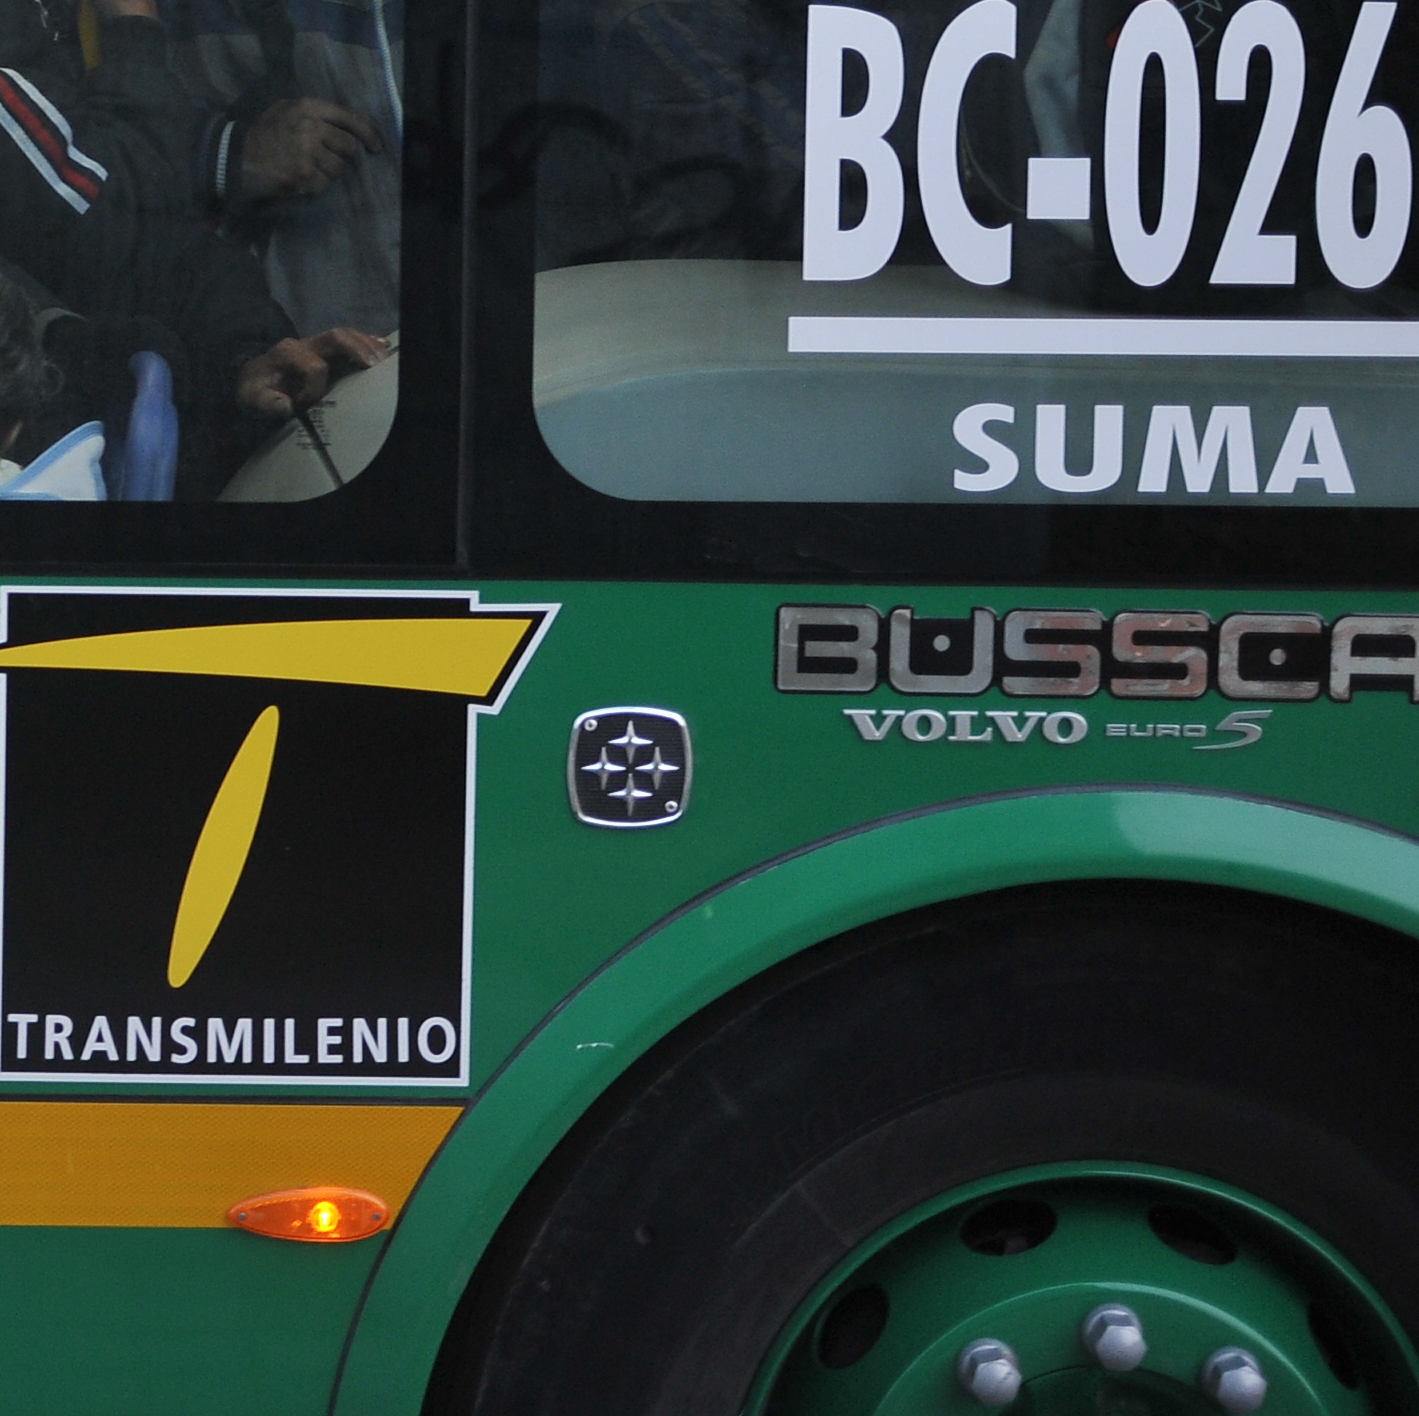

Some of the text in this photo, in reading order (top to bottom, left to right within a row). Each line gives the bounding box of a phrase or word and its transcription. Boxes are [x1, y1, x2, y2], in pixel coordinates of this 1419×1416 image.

[952, 402, 1356, 495] SUMA
[842, 709, 1274, 750] VOLVO EURO 5
[7, 1013, 457, 1064] TRANSMILENIO
